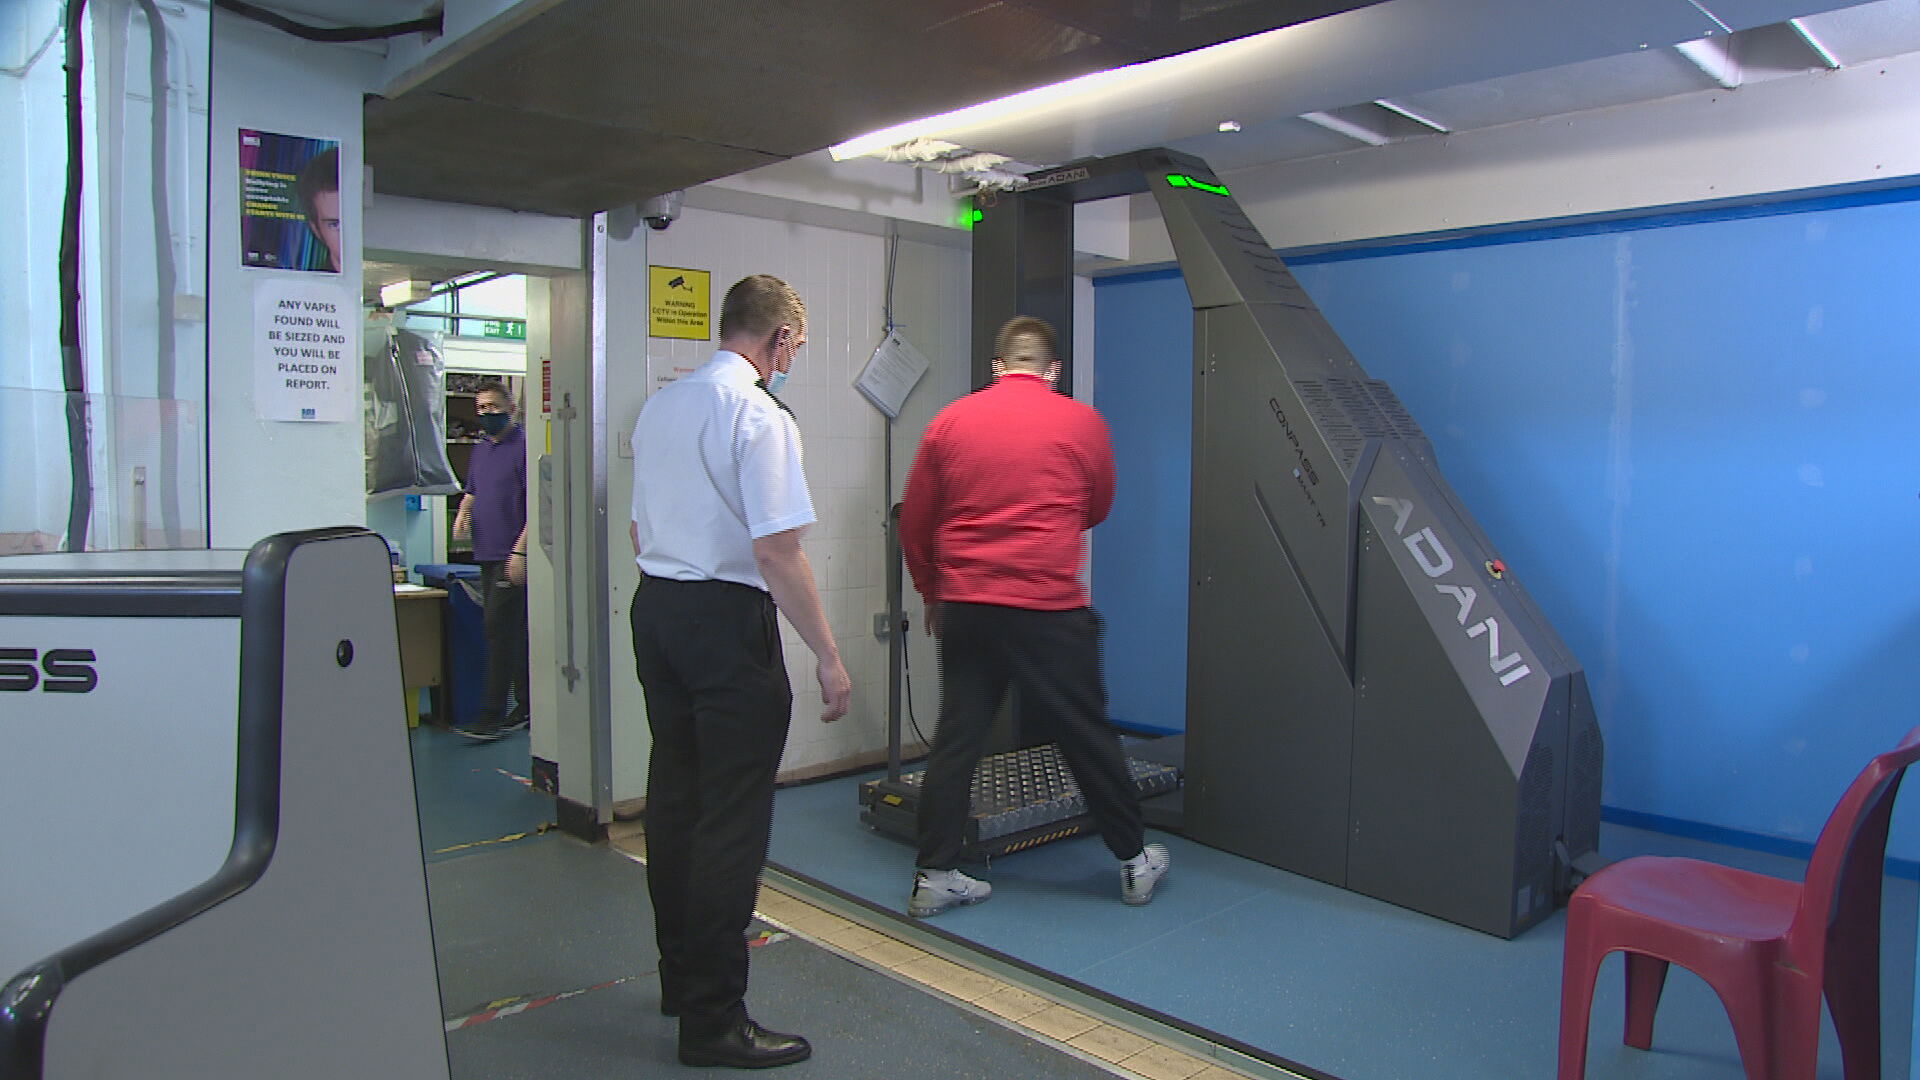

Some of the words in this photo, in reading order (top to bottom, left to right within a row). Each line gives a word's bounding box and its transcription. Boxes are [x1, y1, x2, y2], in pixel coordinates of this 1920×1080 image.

[279, 300, 301, 310] ANY
[304, 302, 336, 313] VAPES
[665, 300, 695, 308] WARNING
[653, 307, 669, 315] CCTV
[274, 315, 313, 326] FOUND
[316, 318, 340, 329] WILL
[657, 316, 676, 325] Within
[269, 331, 282, 340] BE
[285, 332, 320, 343] SIEZED
[323, 334, 345, 344] AND
[274, 347, 298, 357] YOU
[300, 348, 325, 359] WILL
[328, 350, 341, 359] BE
[278, 363, 318, 374] PLACED
[321, 365, 337, 374] ON
[286, 379, 330, 390] REPORT.
[1372, 496, 1531, 686] ADANI
[0, 649, 98, 693] SS
